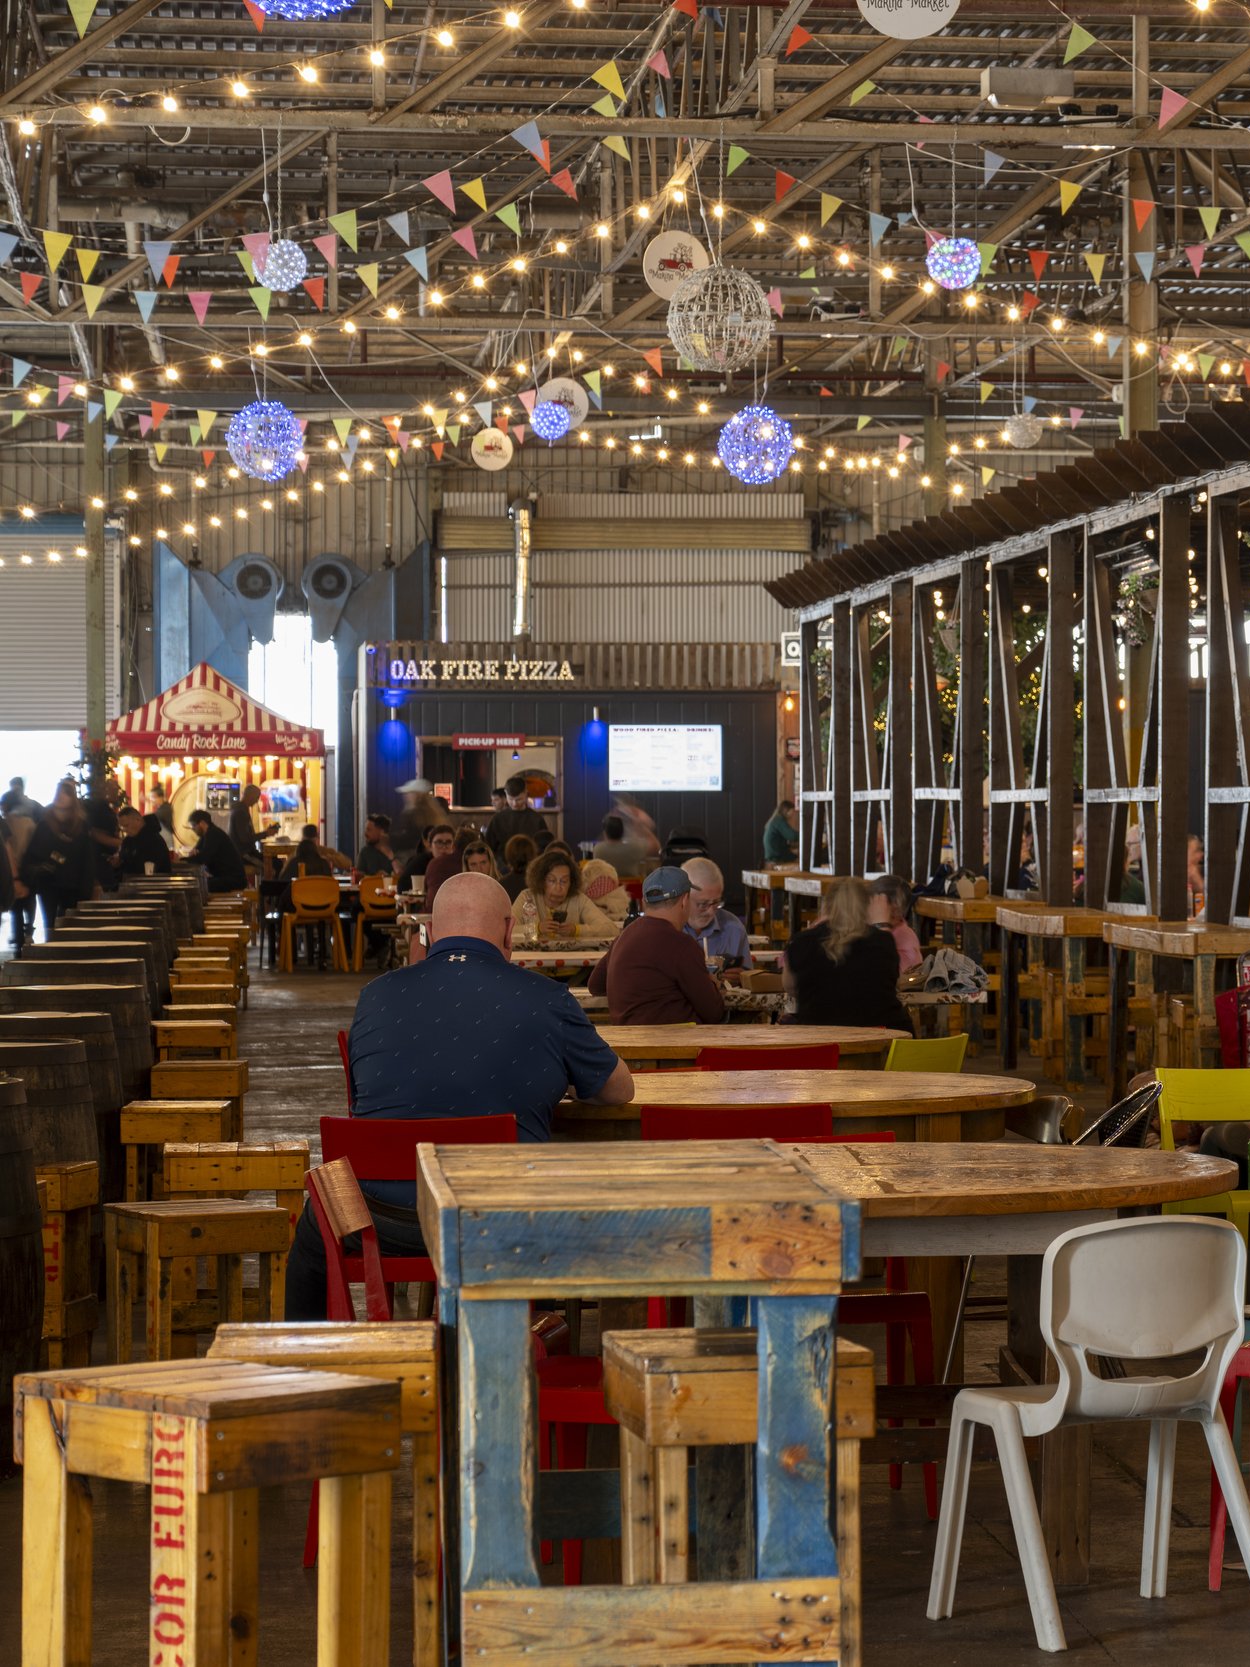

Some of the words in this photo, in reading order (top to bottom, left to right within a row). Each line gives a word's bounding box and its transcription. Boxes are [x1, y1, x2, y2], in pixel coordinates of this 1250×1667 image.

[390, 659, 437, 681] OAK
[440, 659, 500, 681] FIRE
[503, 659, 575, 681] PIZZA
[156, 734, 190, 752] Candy
[192, 733, 219, 750] Rock
[221, 734, 246, 750] Lane
[458, 737, 494, 746] PICK-UP
[496, 737, 520, 746] HERE
